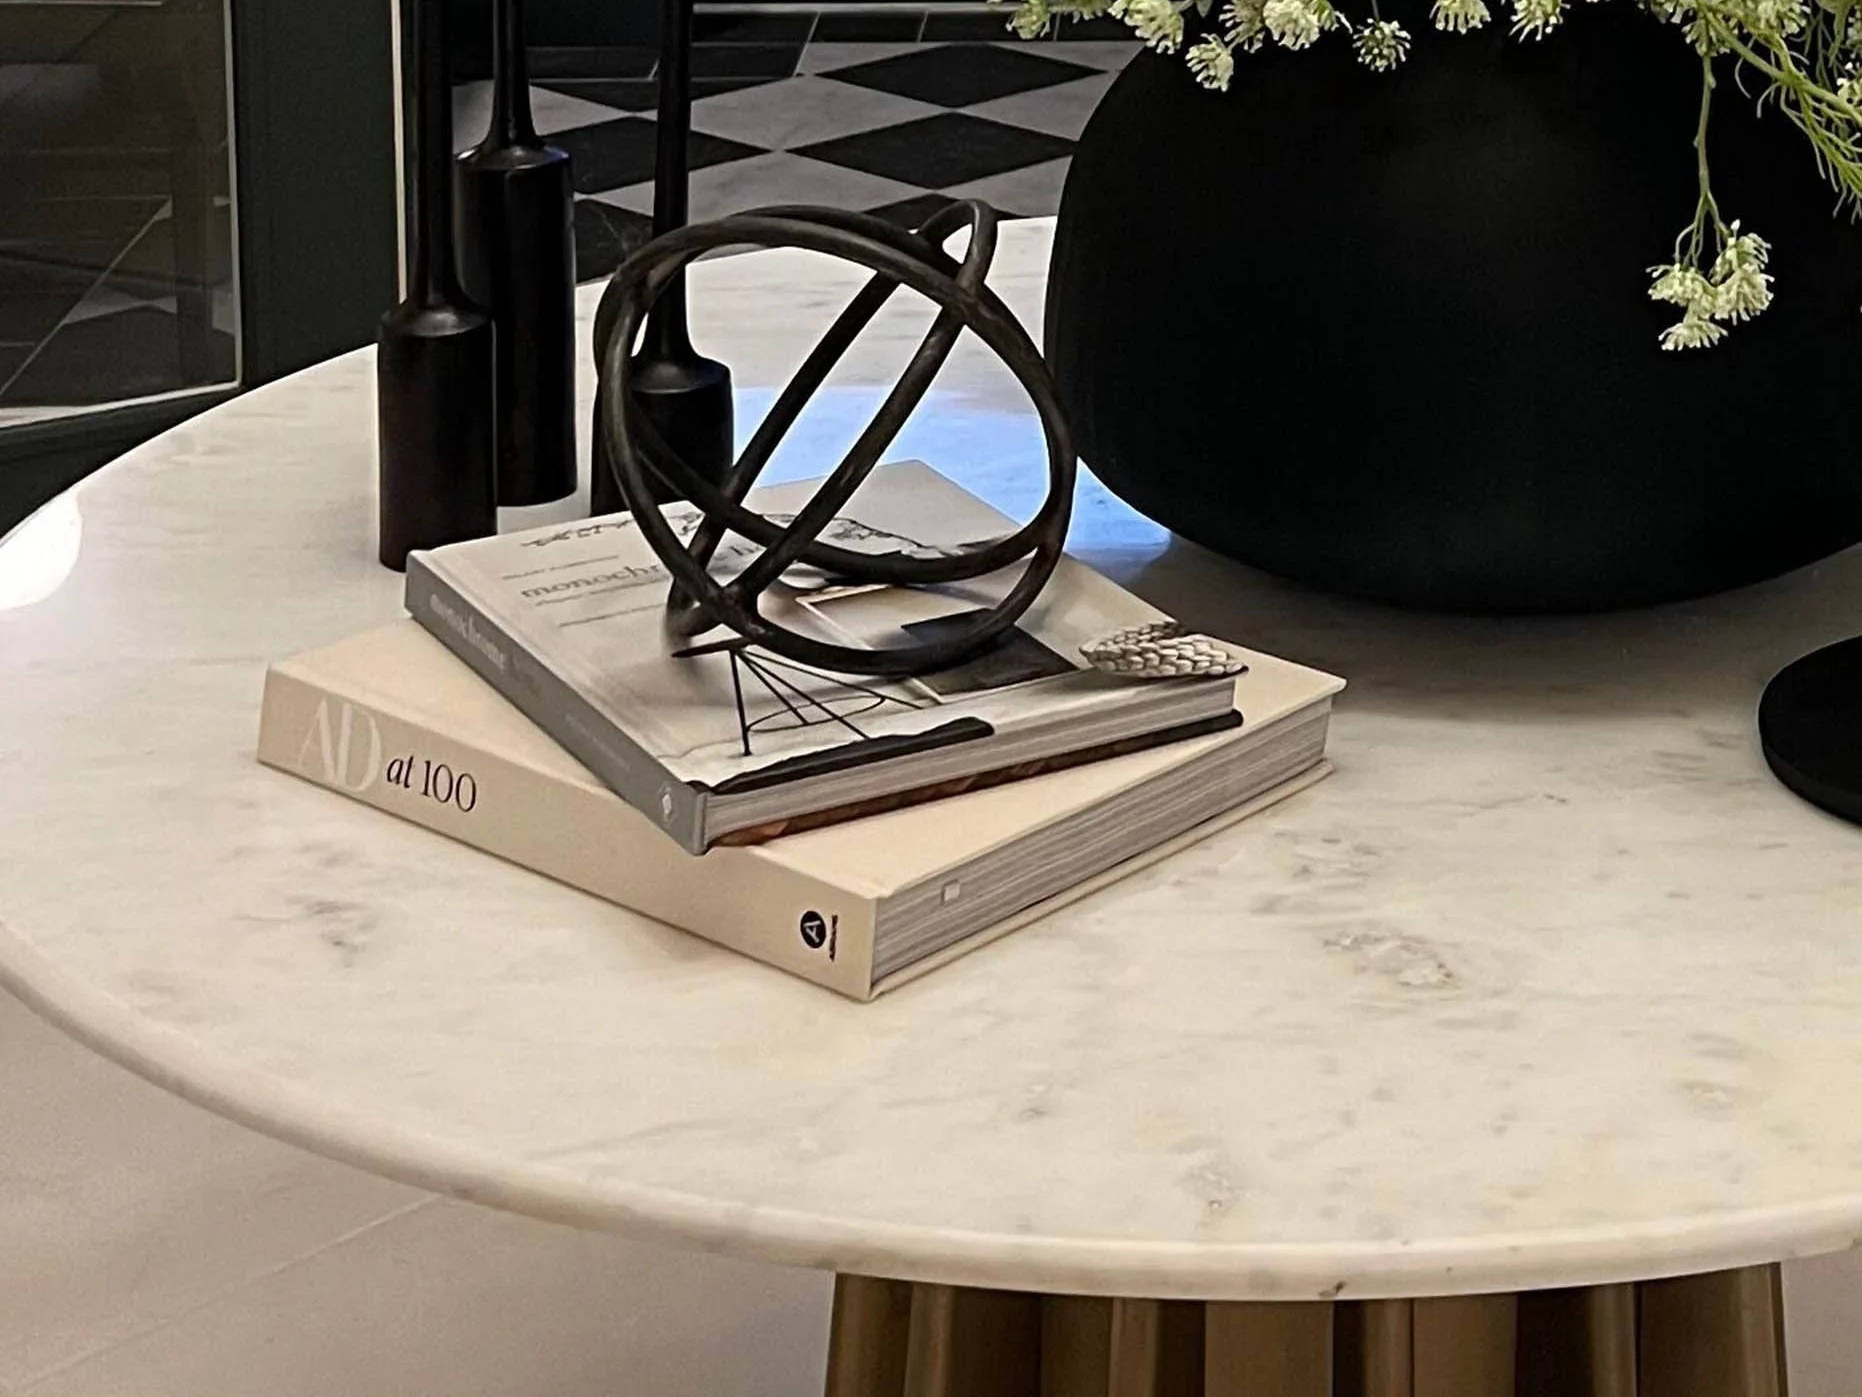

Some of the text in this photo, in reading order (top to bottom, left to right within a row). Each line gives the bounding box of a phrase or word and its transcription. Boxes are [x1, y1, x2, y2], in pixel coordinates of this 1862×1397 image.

[299, 698, 477, 813] AD at 100
